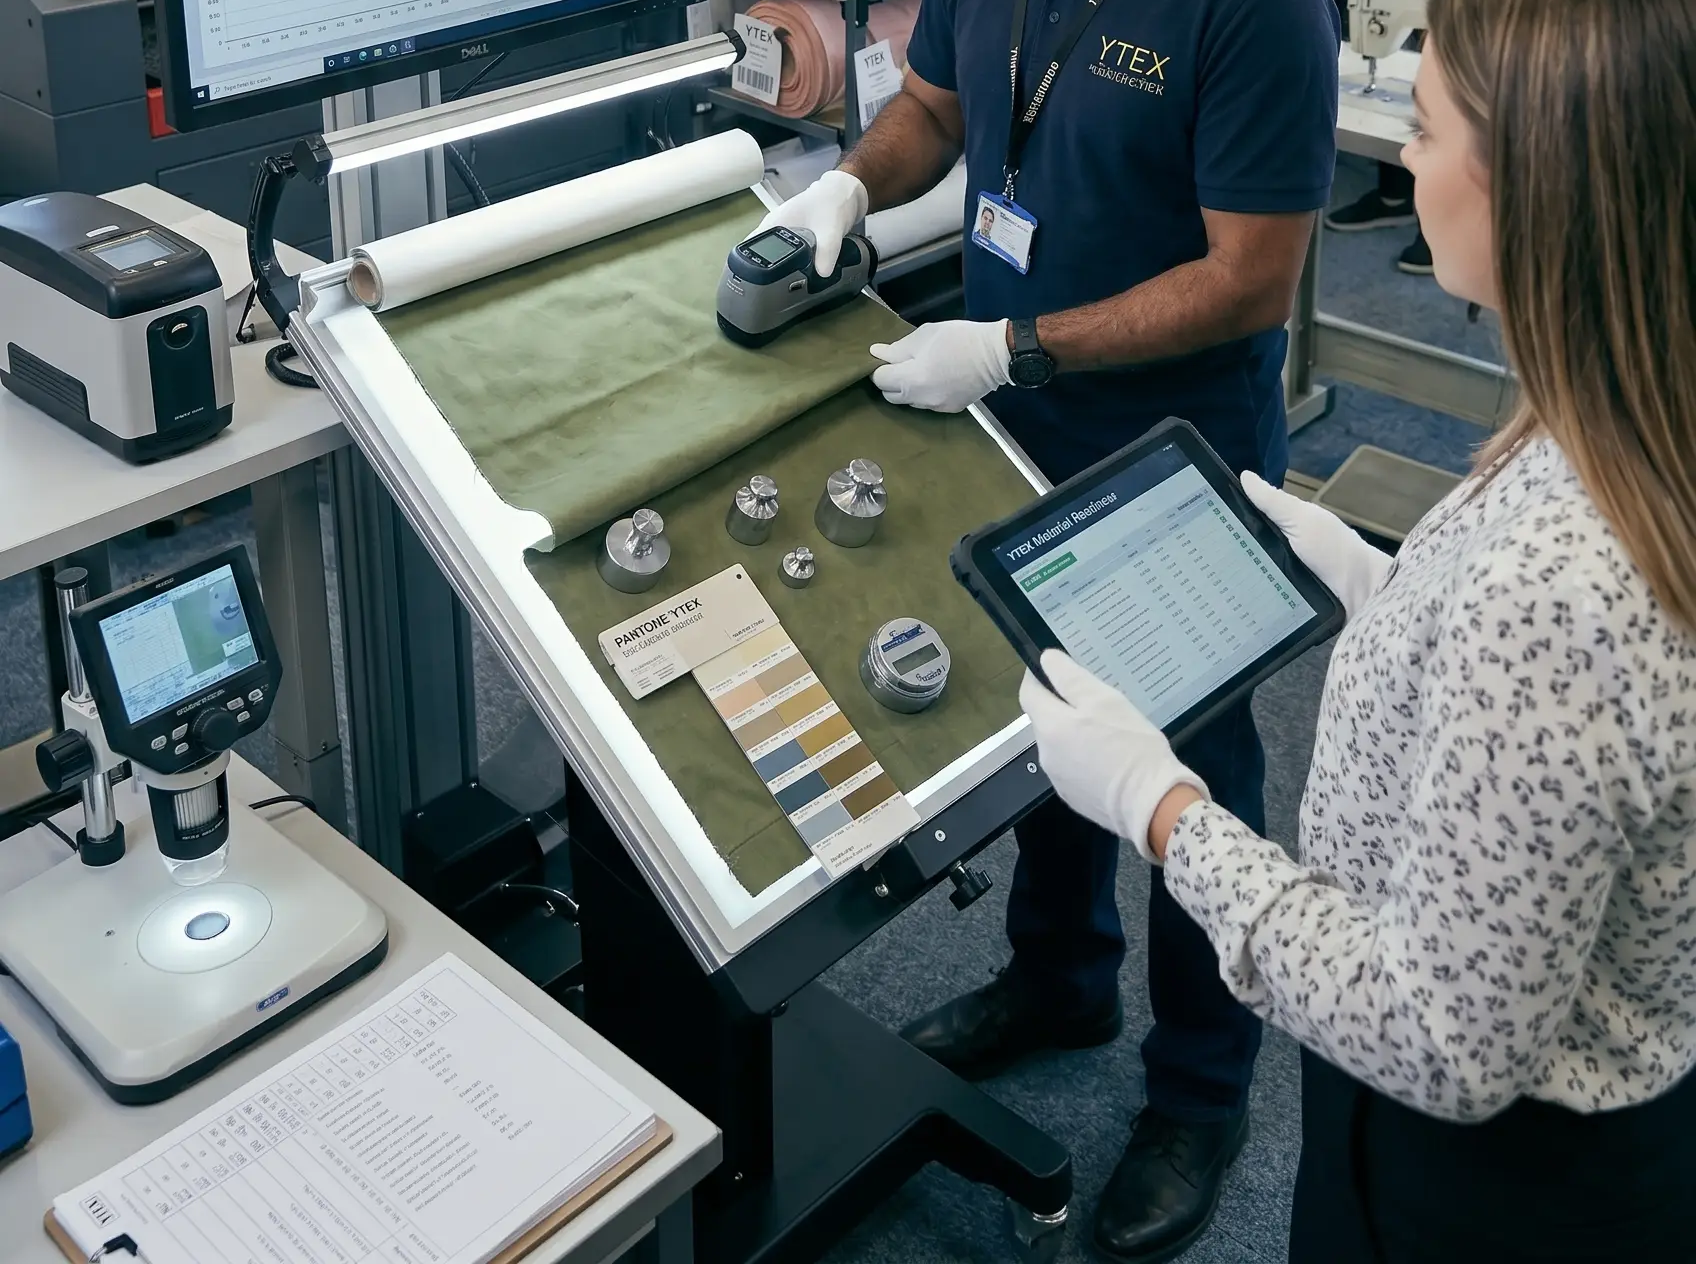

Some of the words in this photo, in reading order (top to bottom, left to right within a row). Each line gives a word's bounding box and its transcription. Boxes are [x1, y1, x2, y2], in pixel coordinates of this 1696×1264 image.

[745, 25, 773, 45] YTEX
[864, 51, 885, 66] YTEX
[1098, 35, 1171, 81] YTEX
[1006, 540, 1035, 561] YTEX
[614, 613, 670, 648] PANTONE
[671, 598, 703, 618] YTEX
